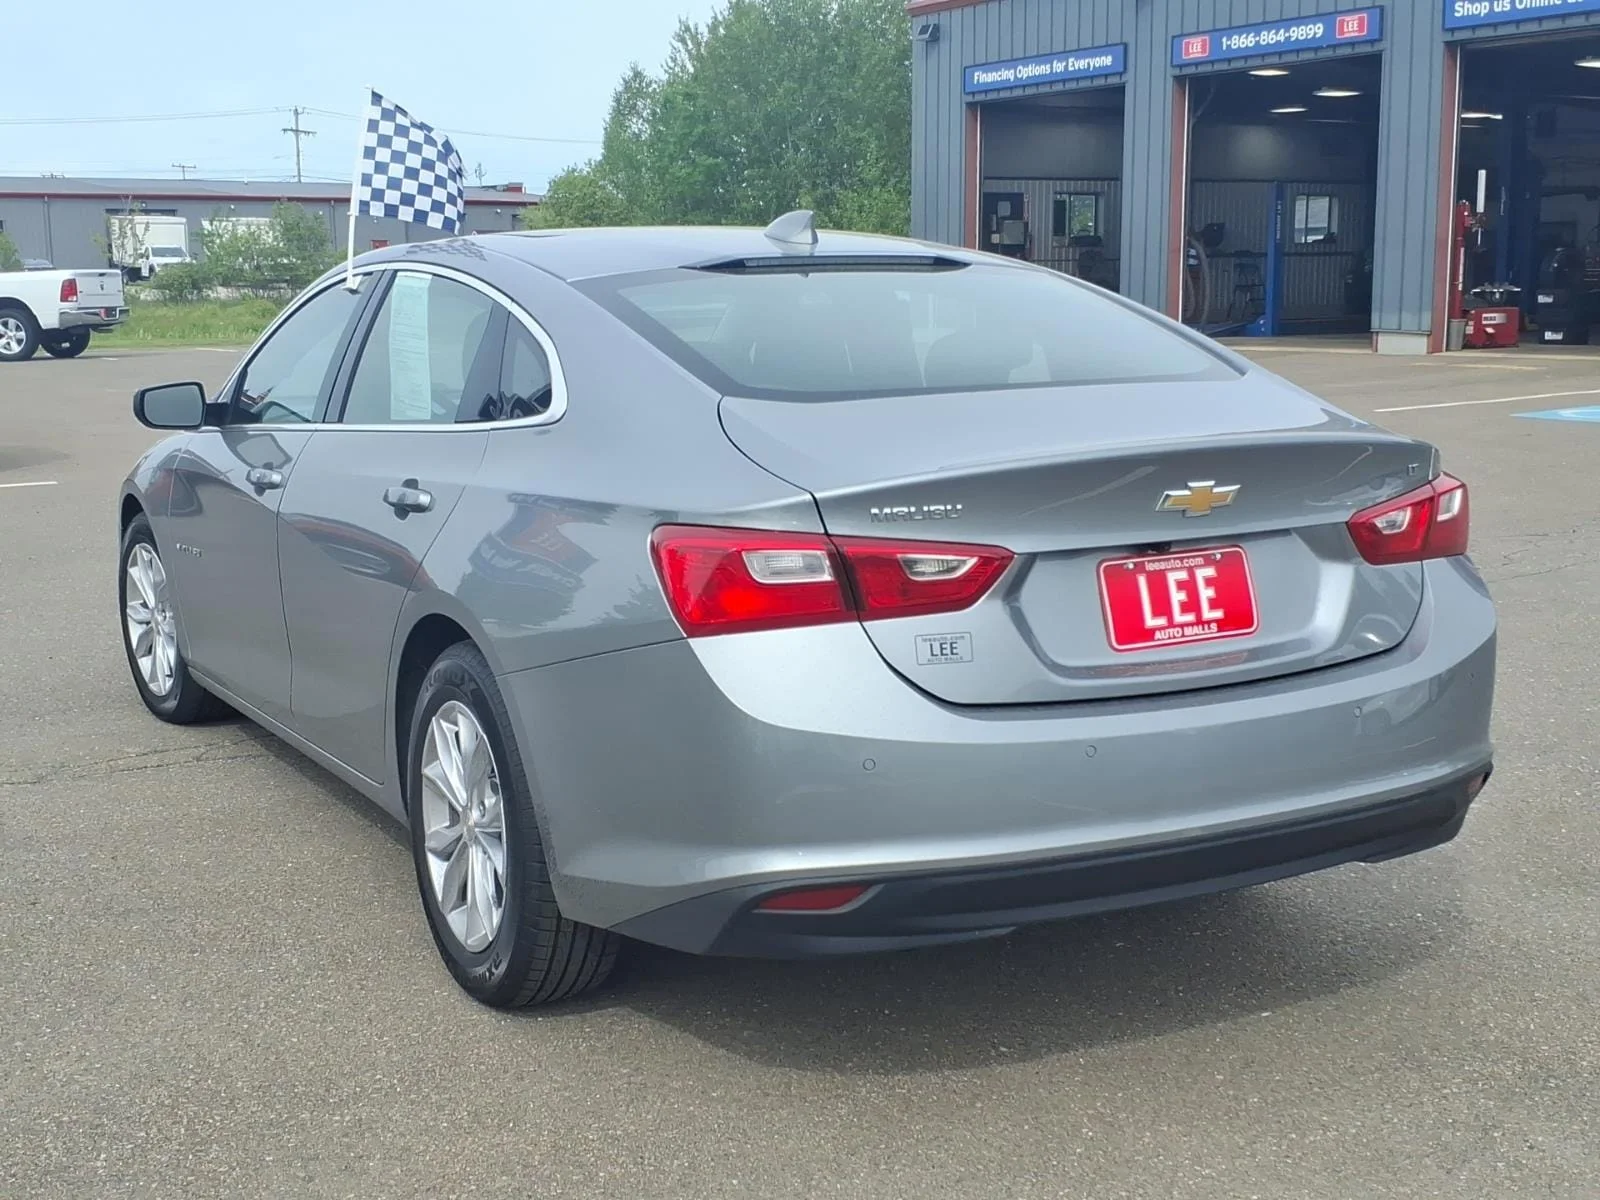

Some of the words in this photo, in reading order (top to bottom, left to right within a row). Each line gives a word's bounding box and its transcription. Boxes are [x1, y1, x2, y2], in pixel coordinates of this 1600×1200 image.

[1454, 1, 1489, 17] Shop
[1493, 0, 1511, 12] us
[1343, 20, 1359, 32] LEE
[1221, 23, 1324, 50] 1-866-864-9899
[1188, 42, 1202, 53] LEE
[974, 67, 1014, 84] Financing
[1016, 62, 1050, 79] Options
[1053, 60, 1066, 73] for
[1068, 55, 1112, 71] Everyone
[870, 504, 962, 523] MALIBU
[1145, 557, 1204, 571] leeauto.com
[1136, 566, 1225, 629] LEE
[1154, 627, 1182, 640] AUTO
[1184, 622, 1218, 636] MALLS
[929, 641, 959, 656] LEE
